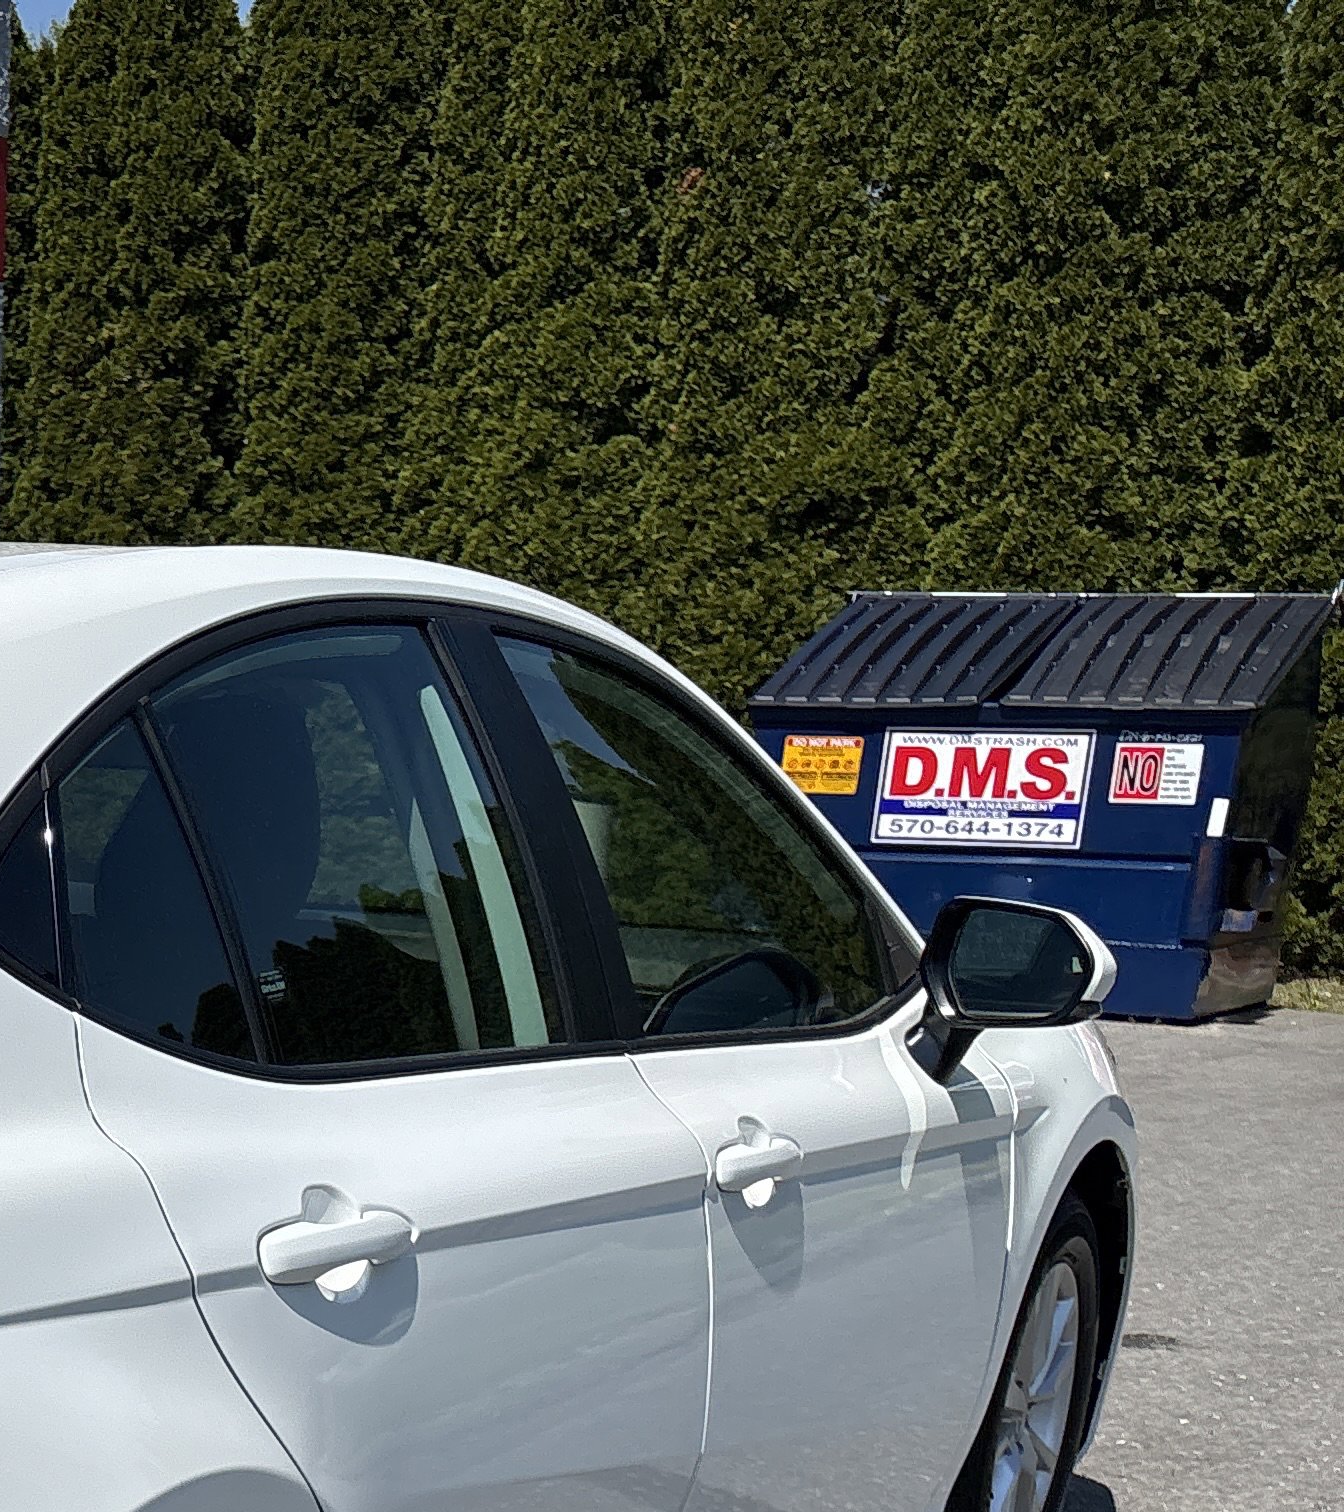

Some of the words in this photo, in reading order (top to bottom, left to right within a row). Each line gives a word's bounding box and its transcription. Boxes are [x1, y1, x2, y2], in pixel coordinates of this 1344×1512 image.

[902, 735, 1079, 748] WWW.DMSTRASH.COM
[889, 746, 1076, 800] D.M.S.
[1116, 752, 1160, 795] NO
[903, 800, 963, 810] DISPOSAL
[966, 801, 1056, 812] MANAGEMENT
[889, 818, 1065, 838] 570-644-1374
